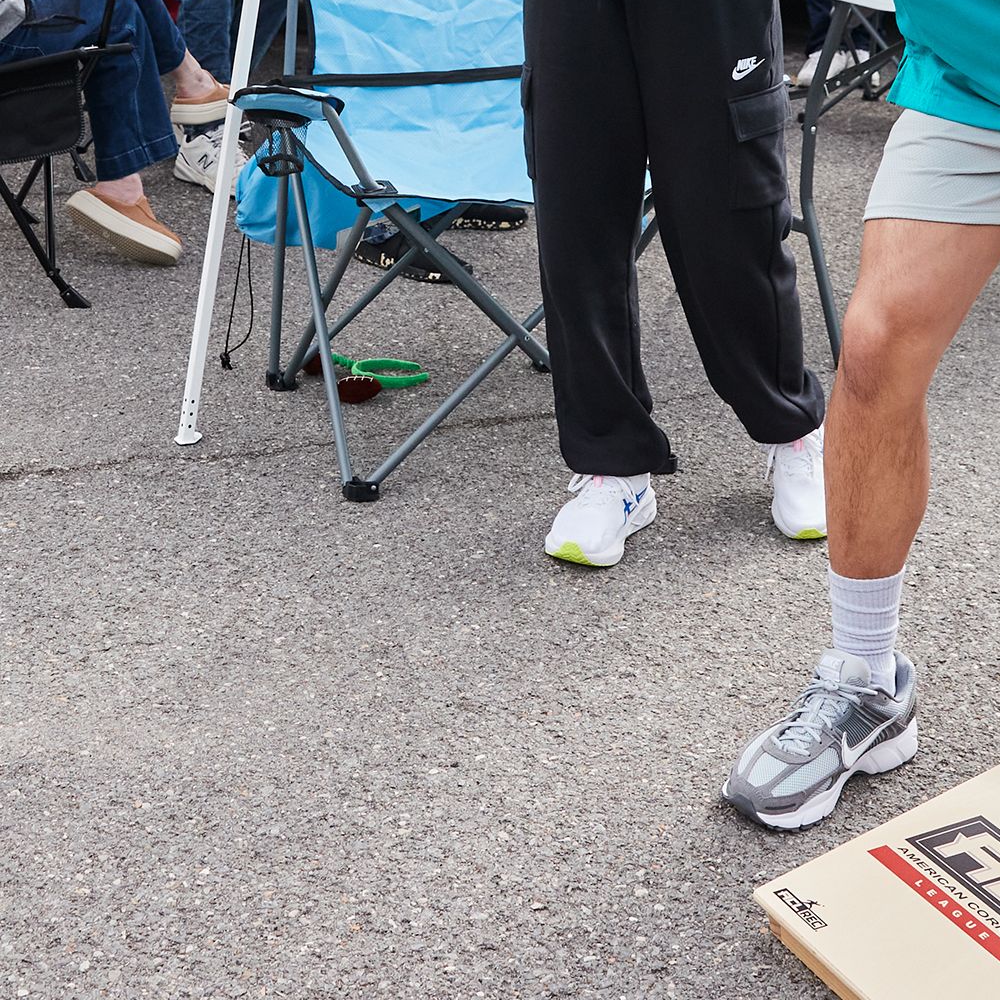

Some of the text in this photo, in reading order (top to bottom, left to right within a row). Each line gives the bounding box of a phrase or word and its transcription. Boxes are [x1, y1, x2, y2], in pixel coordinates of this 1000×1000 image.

[897, 846, 968, 900] AMERICAN
[800, 910, 823, 928] REC
[914, 879, 991, 941] LEAGUE
